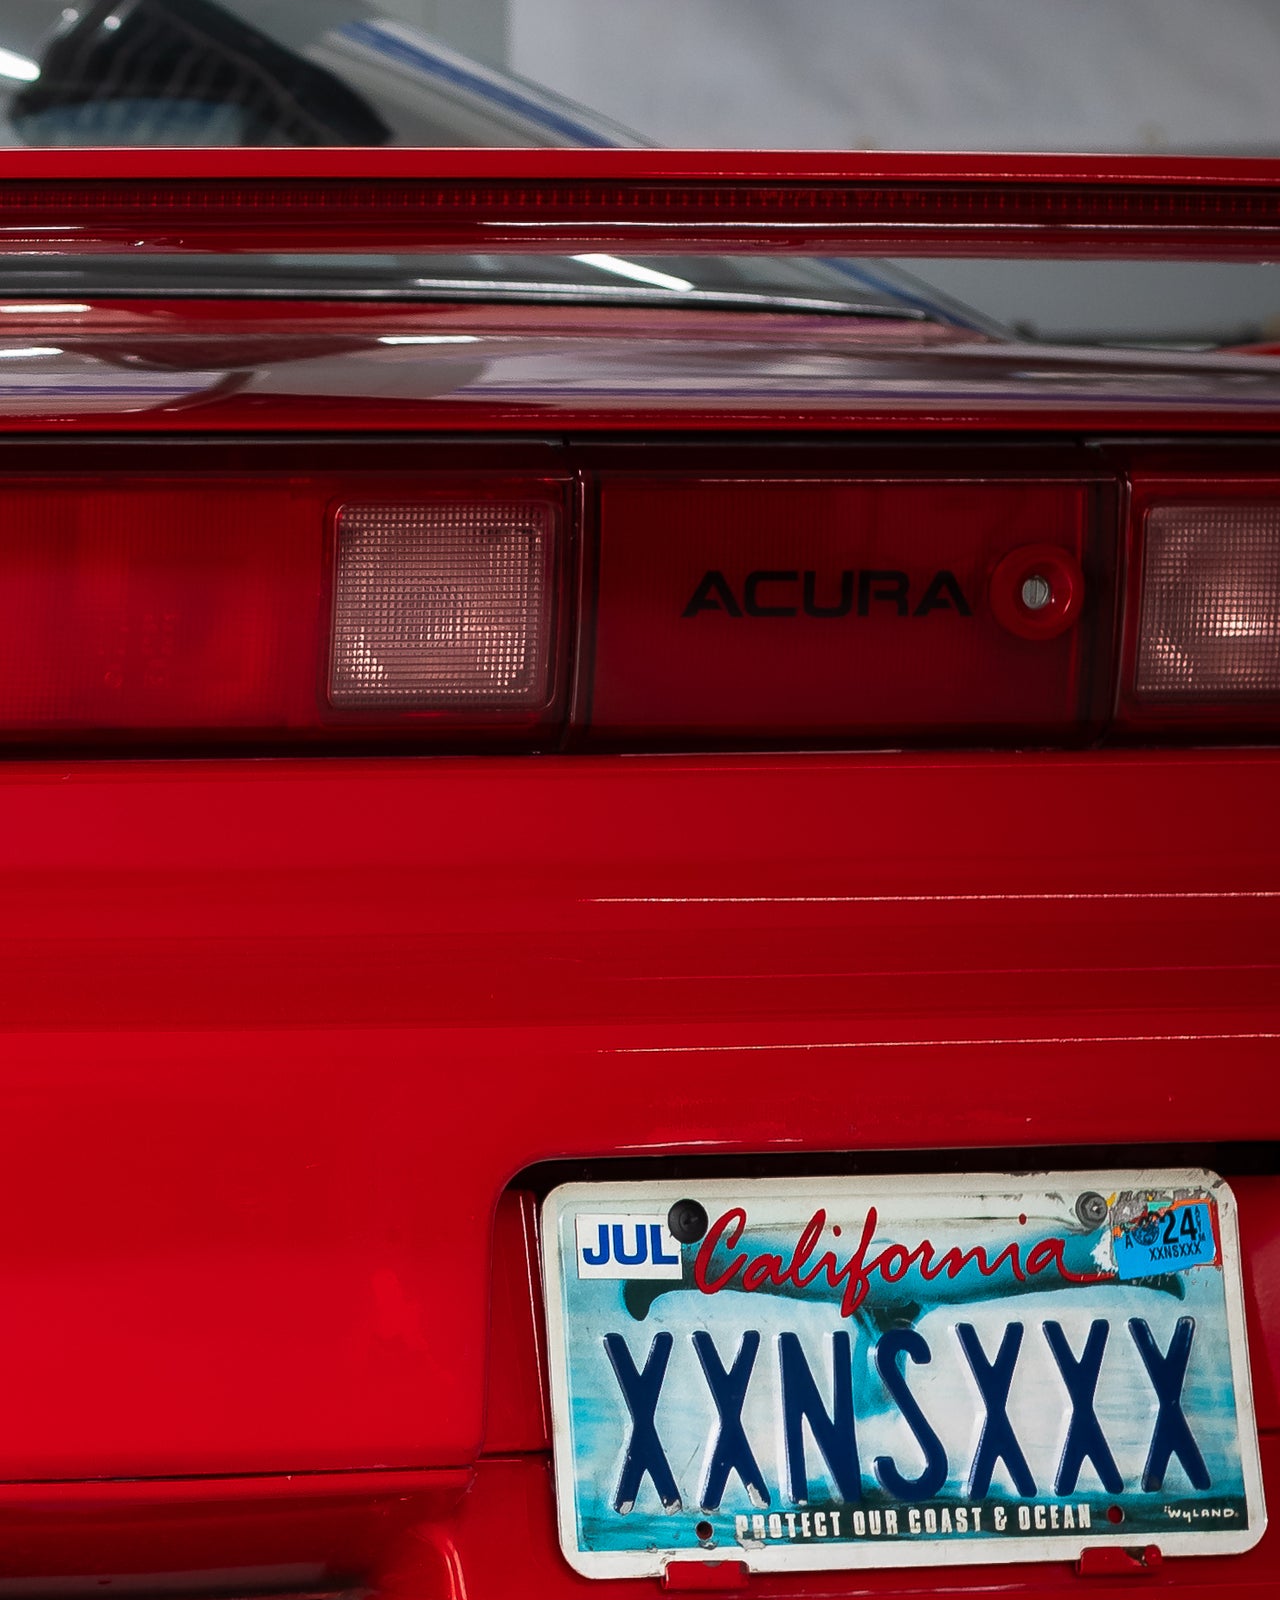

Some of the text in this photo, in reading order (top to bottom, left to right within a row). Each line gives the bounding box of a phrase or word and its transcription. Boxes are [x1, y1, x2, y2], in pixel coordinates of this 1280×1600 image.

[682, 570, 973, 618] ACURA
[1159, 1208, 1197, 1245] 24
[582, 1223, 680, 1266] JUL
[694, 1206, 1115, 1317] California
[1148, 1242, 1203, 1261] XXNSXXX
[603, 1316, 1211, 1514] XXNSXXX
[735, 1504, 1091, 1540] PROTECT OUR COAST & OCEAN
